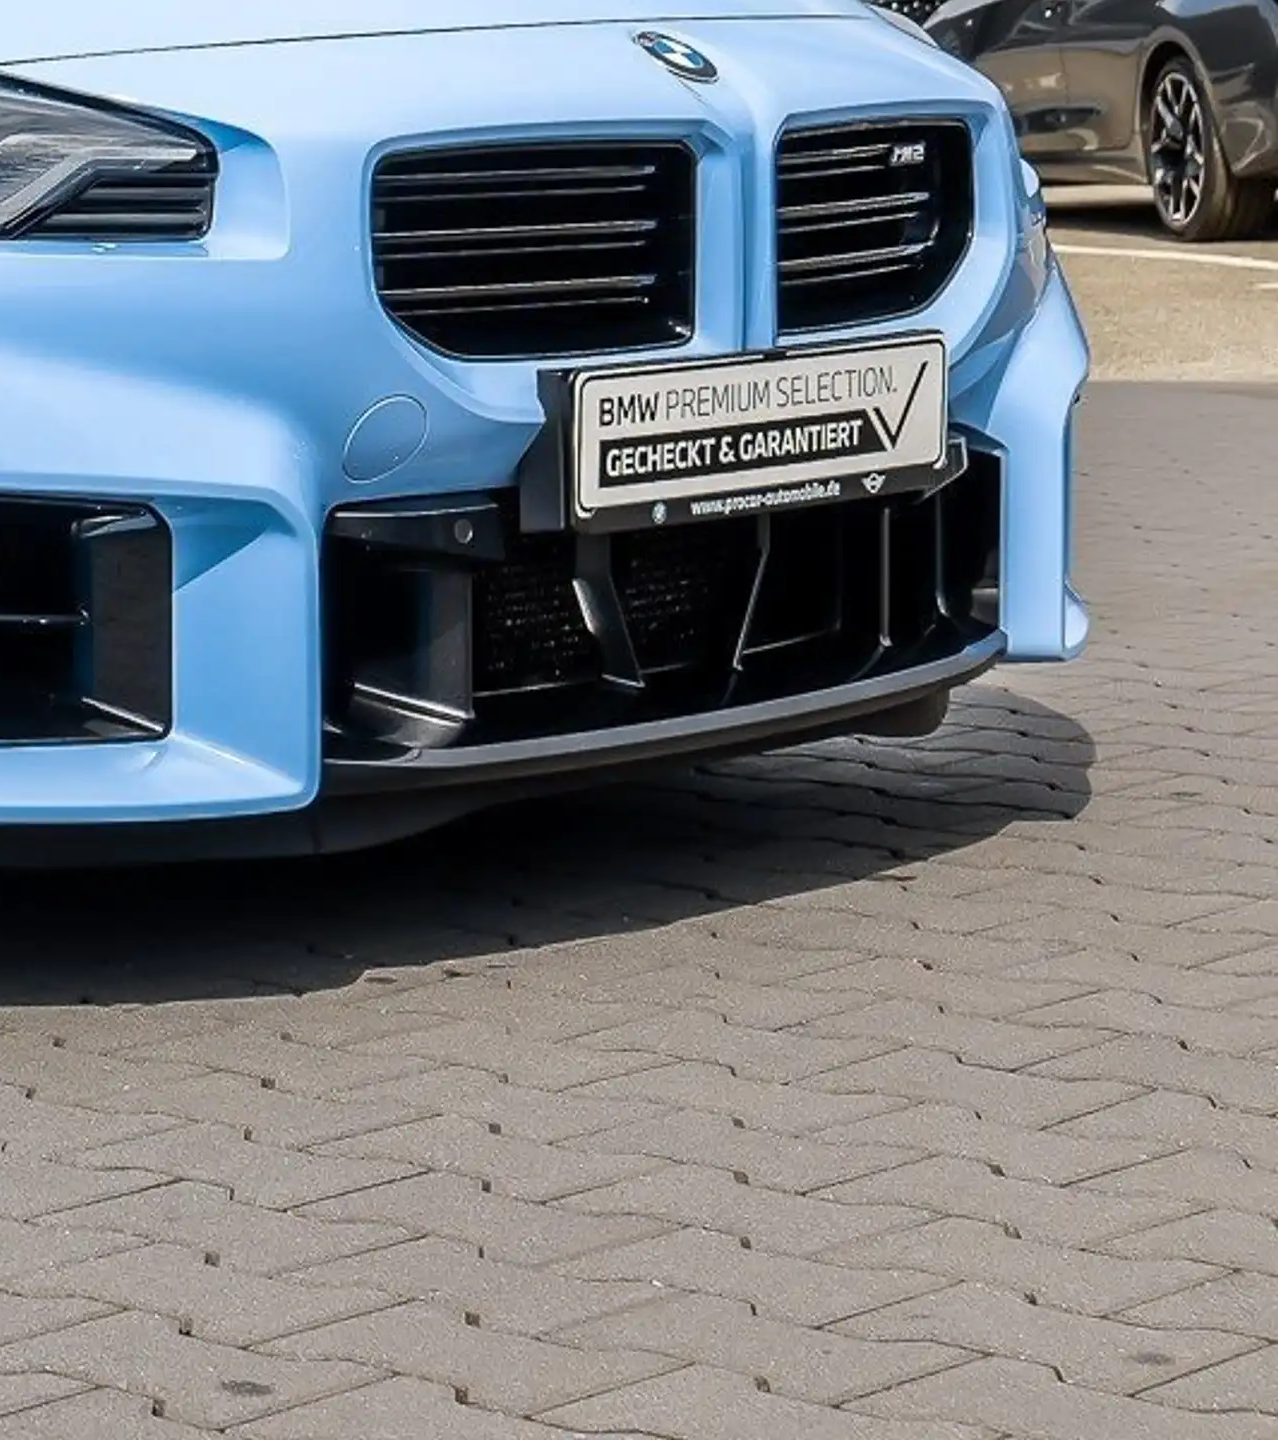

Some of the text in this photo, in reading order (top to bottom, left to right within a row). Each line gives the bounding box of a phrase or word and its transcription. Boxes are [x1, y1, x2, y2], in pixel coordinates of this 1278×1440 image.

[599, 365, 898, 427] BMW PREMIUM SELECTION.
[606, 418, 864, 478] GECHECKT & GARANTIERT
[690, 479, 841, 516] www.procar-automobile.de
